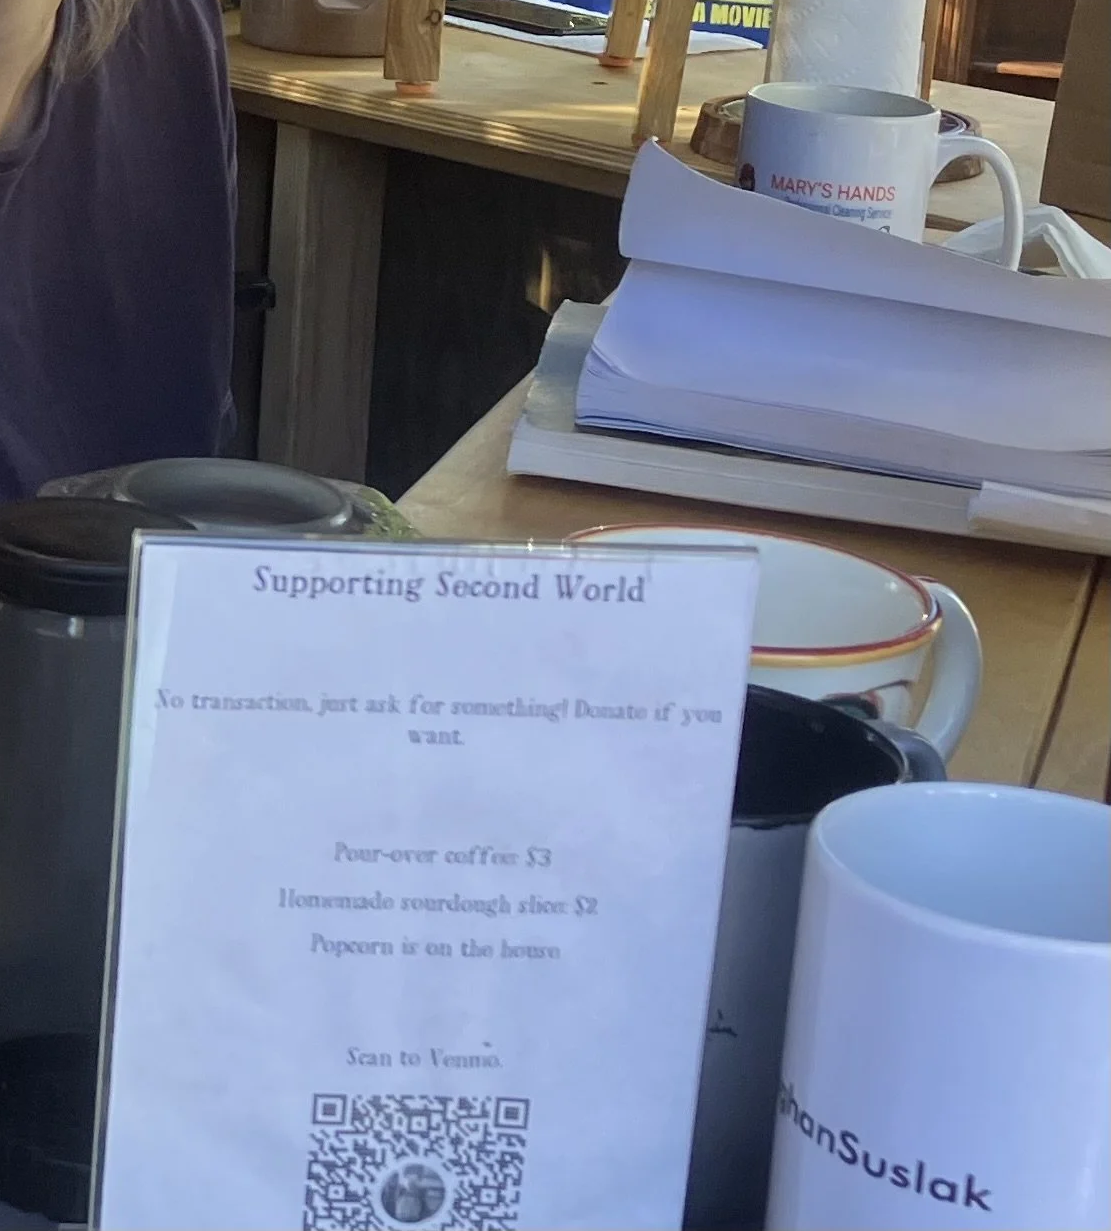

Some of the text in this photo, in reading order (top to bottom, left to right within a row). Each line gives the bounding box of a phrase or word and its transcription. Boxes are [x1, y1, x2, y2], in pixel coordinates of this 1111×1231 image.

[710, 2, 773, 29] MOVIE
[770, 173, 896, 202] MARY'S HANDS
[252, 565, 648, 603] Supporting Second World
[154, 688, 185, 710] No
[316, 693, 359, 717] just
[363, 694, 401, 715] ask
[408, 693, 446, 715] for
[574, 698, 648, 721] Donate
[653, 701, 677, 722] if
[680, 708, 723, 727] you
[333, 841, 439, 865] Pour-over
[525, 845, 553, 869] $3
[277, 887, 395, 911] Homemade
[400, 893, 512, 918] sourdough
[574, 895, 599, 919] $2
[310, 932, 561, 961] Popcorn is on the house
[345, 1046, 392, 1068] Scan
[399, 1050, 422, 1068] to
